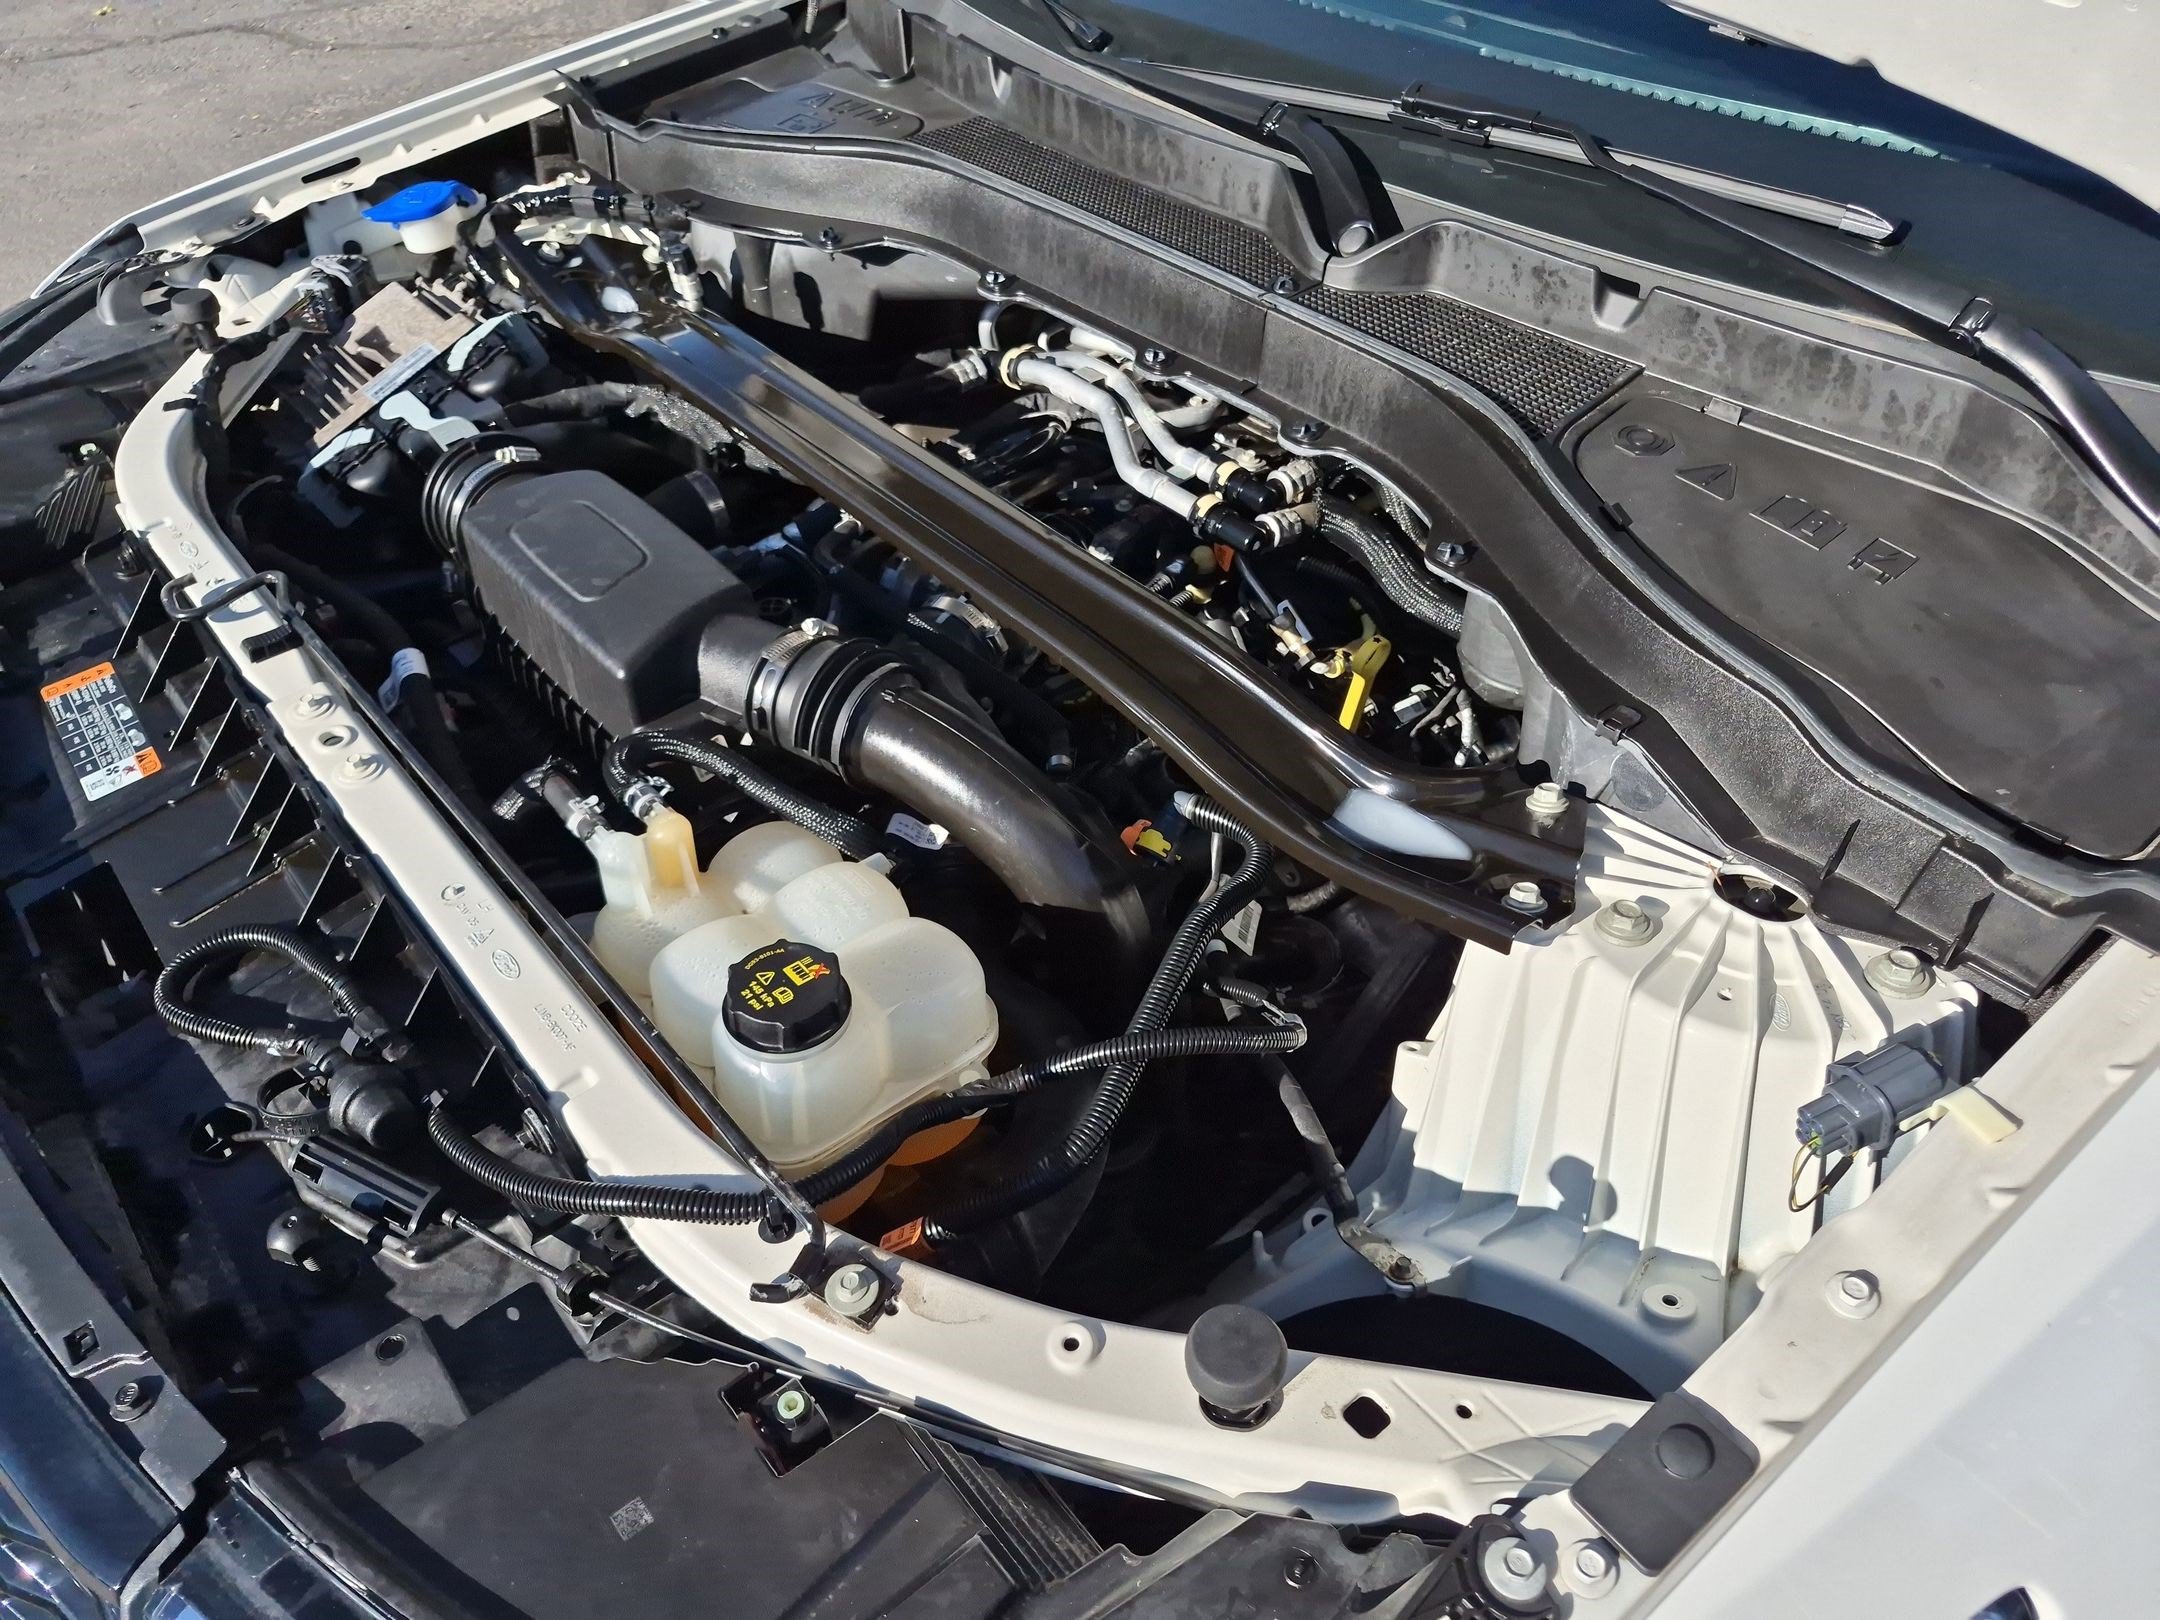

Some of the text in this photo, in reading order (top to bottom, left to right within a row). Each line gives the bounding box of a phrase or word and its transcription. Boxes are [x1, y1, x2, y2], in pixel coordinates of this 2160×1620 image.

[741, 989, 764, 1010] 21 psi
[749, 981, 775, 1008] 145 kPa
